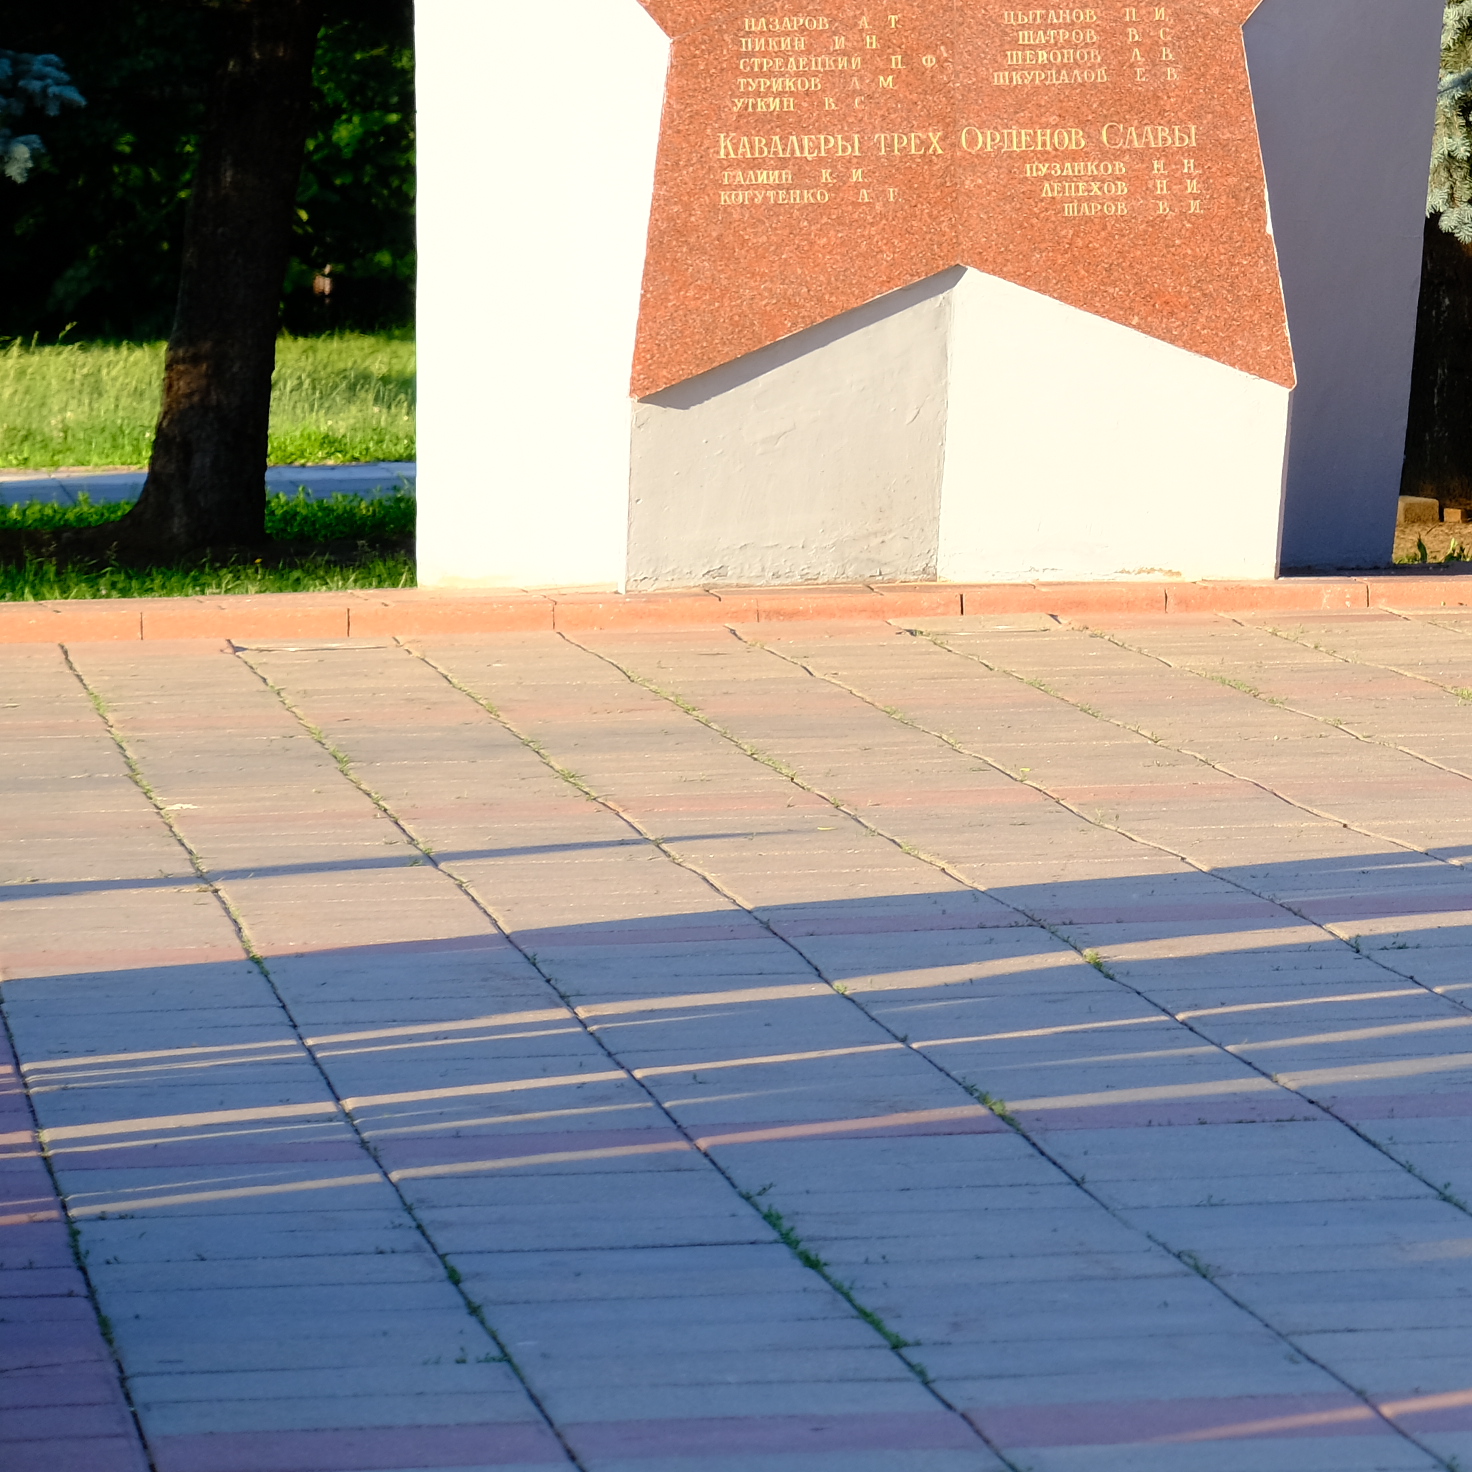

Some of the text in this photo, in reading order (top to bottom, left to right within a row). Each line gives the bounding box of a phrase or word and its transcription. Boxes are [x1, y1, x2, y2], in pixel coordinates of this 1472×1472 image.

[744, 17, 829, 31] НАЗАРОВ
[1004, 8, 1097, 25] ЦЫГАНОВ
[1018, 29, 1098, 45] ШАТРОВ
[737, 76, 821, 92] ТУРИКОВ
[993, 67, 1109, 86] ШКУРДАЛОВ
[732, 97, 795, 112] УТКИН
[717, 123, 1197, 159] КАВАЛЕРЫ ТРЕХ ОРДЕНОВ СЛАВЫ
[1026, 161, 1126, 177] ПУЗАНКОВ
[720, 188, 829, 205] КОГУТЕНКО
[1042, 181, 1128, 197] ЛЕПЕХОВ
[1064, 201, 1128, 216] ШАРОВ
